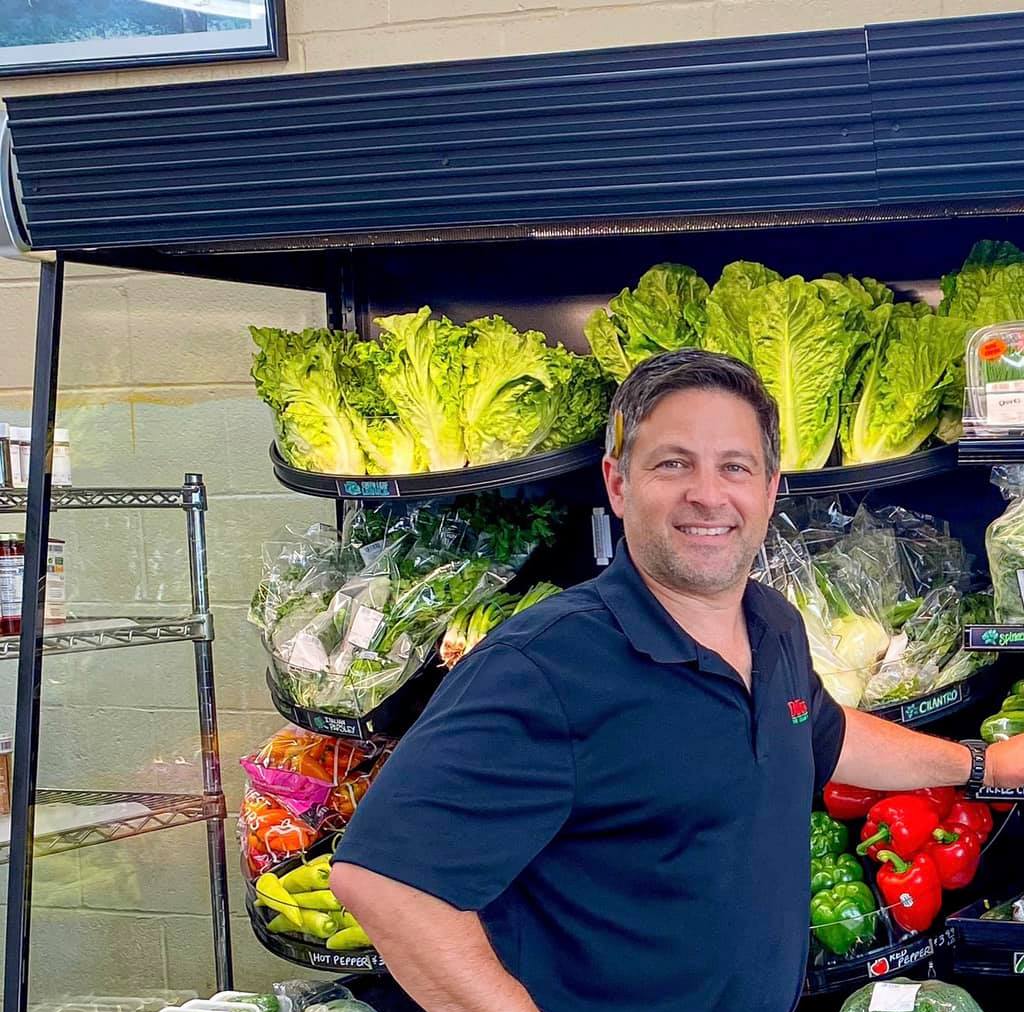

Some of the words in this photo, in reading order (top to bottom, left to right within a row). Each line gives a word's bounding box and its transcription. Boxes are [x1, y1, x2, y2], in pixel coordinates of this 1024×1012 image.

[919, 689, 958, 713] CILANTRO
[313, 952, 331, 964] HOT
[333, 954, 369, 967] PEPPER
